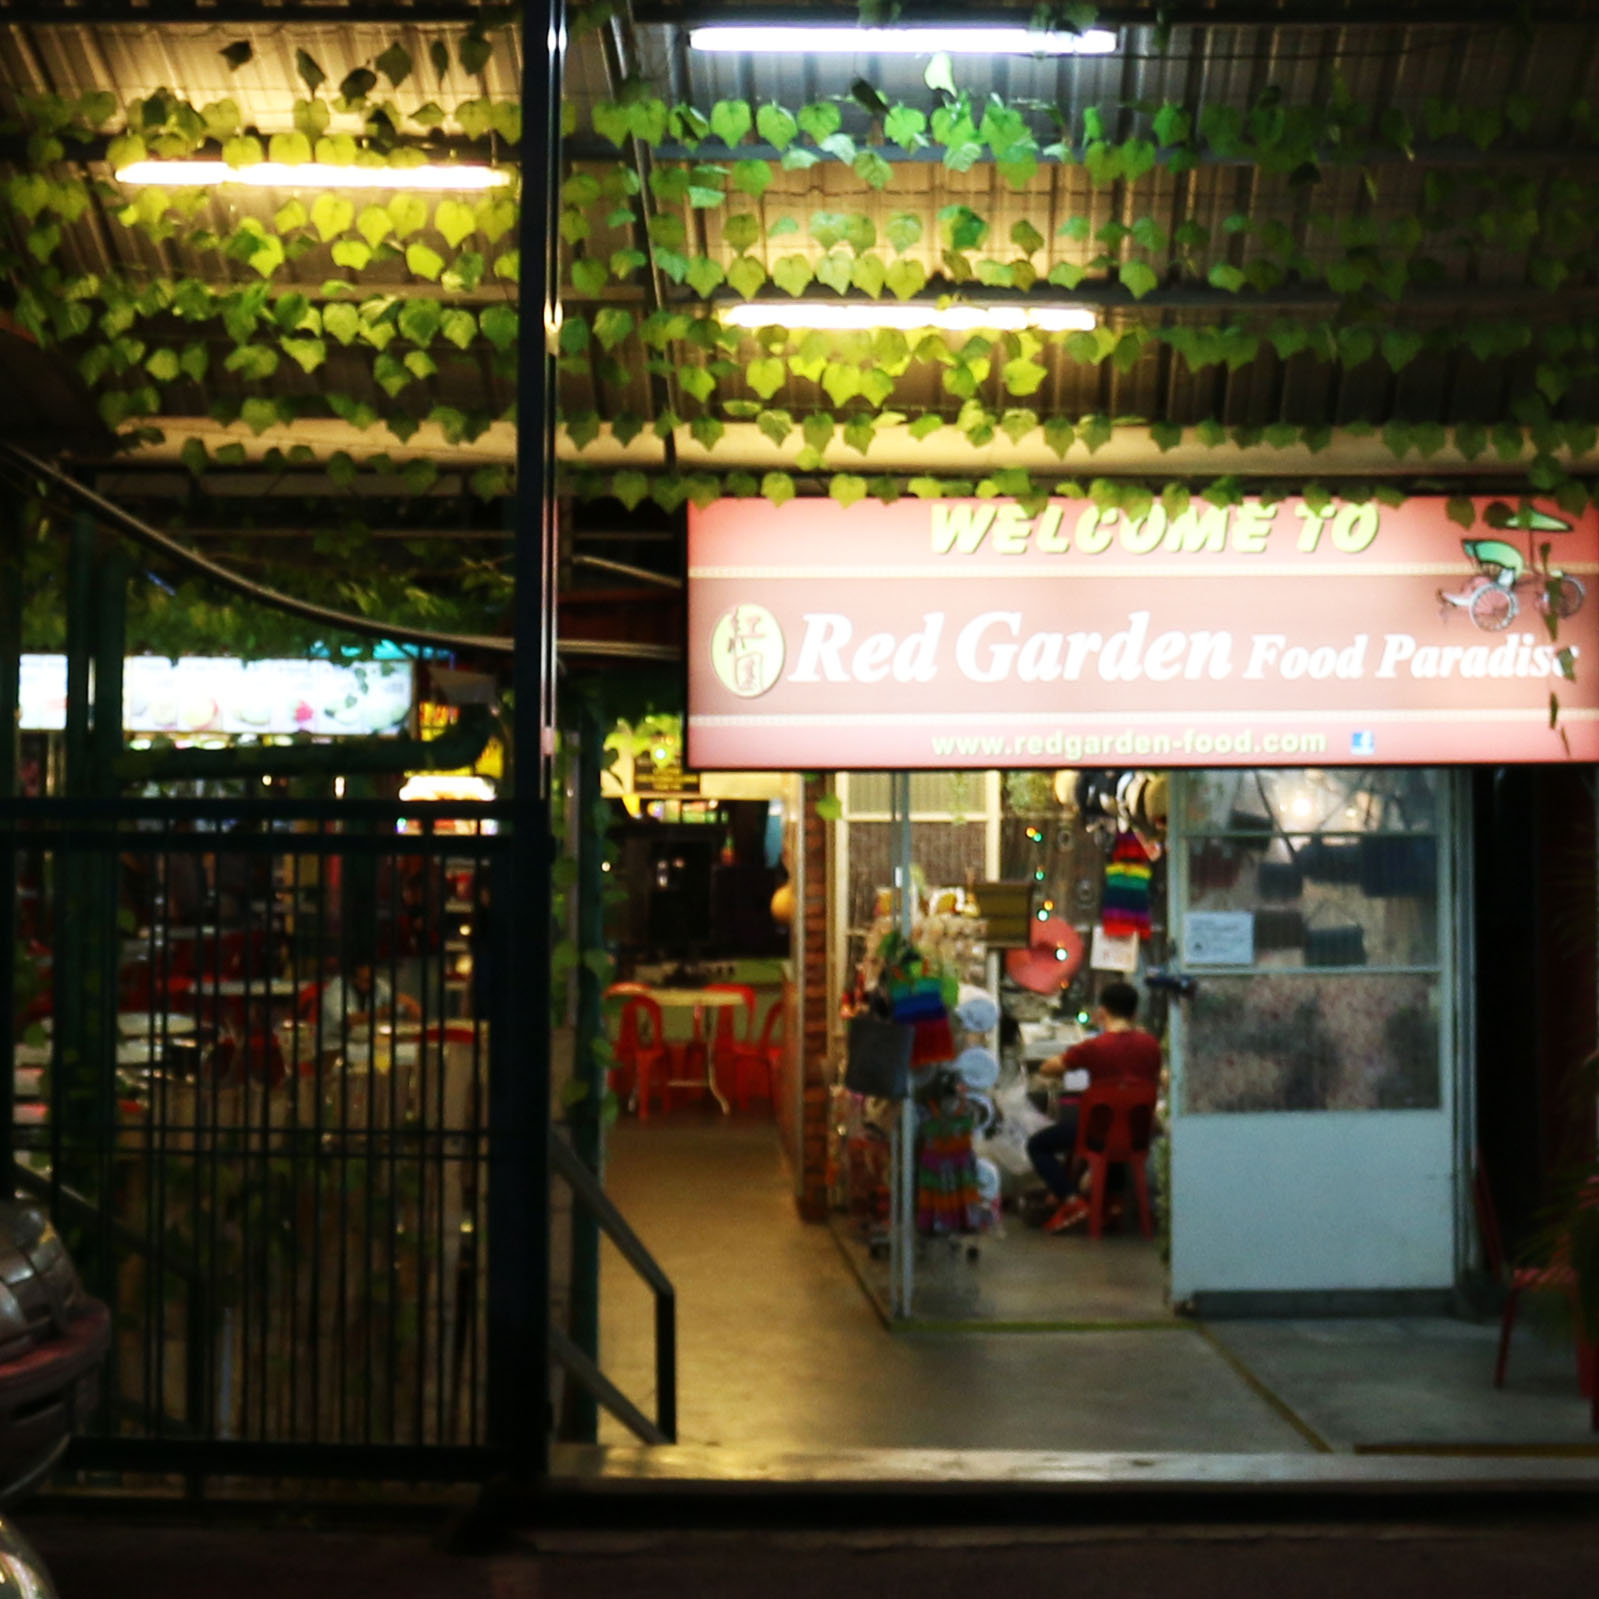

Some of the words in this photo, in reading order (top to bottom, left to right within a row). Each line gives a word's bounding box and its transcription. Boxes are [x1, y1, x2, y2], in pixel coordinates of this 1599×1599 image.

[929, 501, 1280, 556] WELCOME
[1293, 501, 1382, 556] TO
[786, 610, 946, 684] Red
[954, 610, 1234, 685] Garden
[1243, 632, 1369, 681] Food
[931, 729, 1328, 761] www.redgarden-food.com
